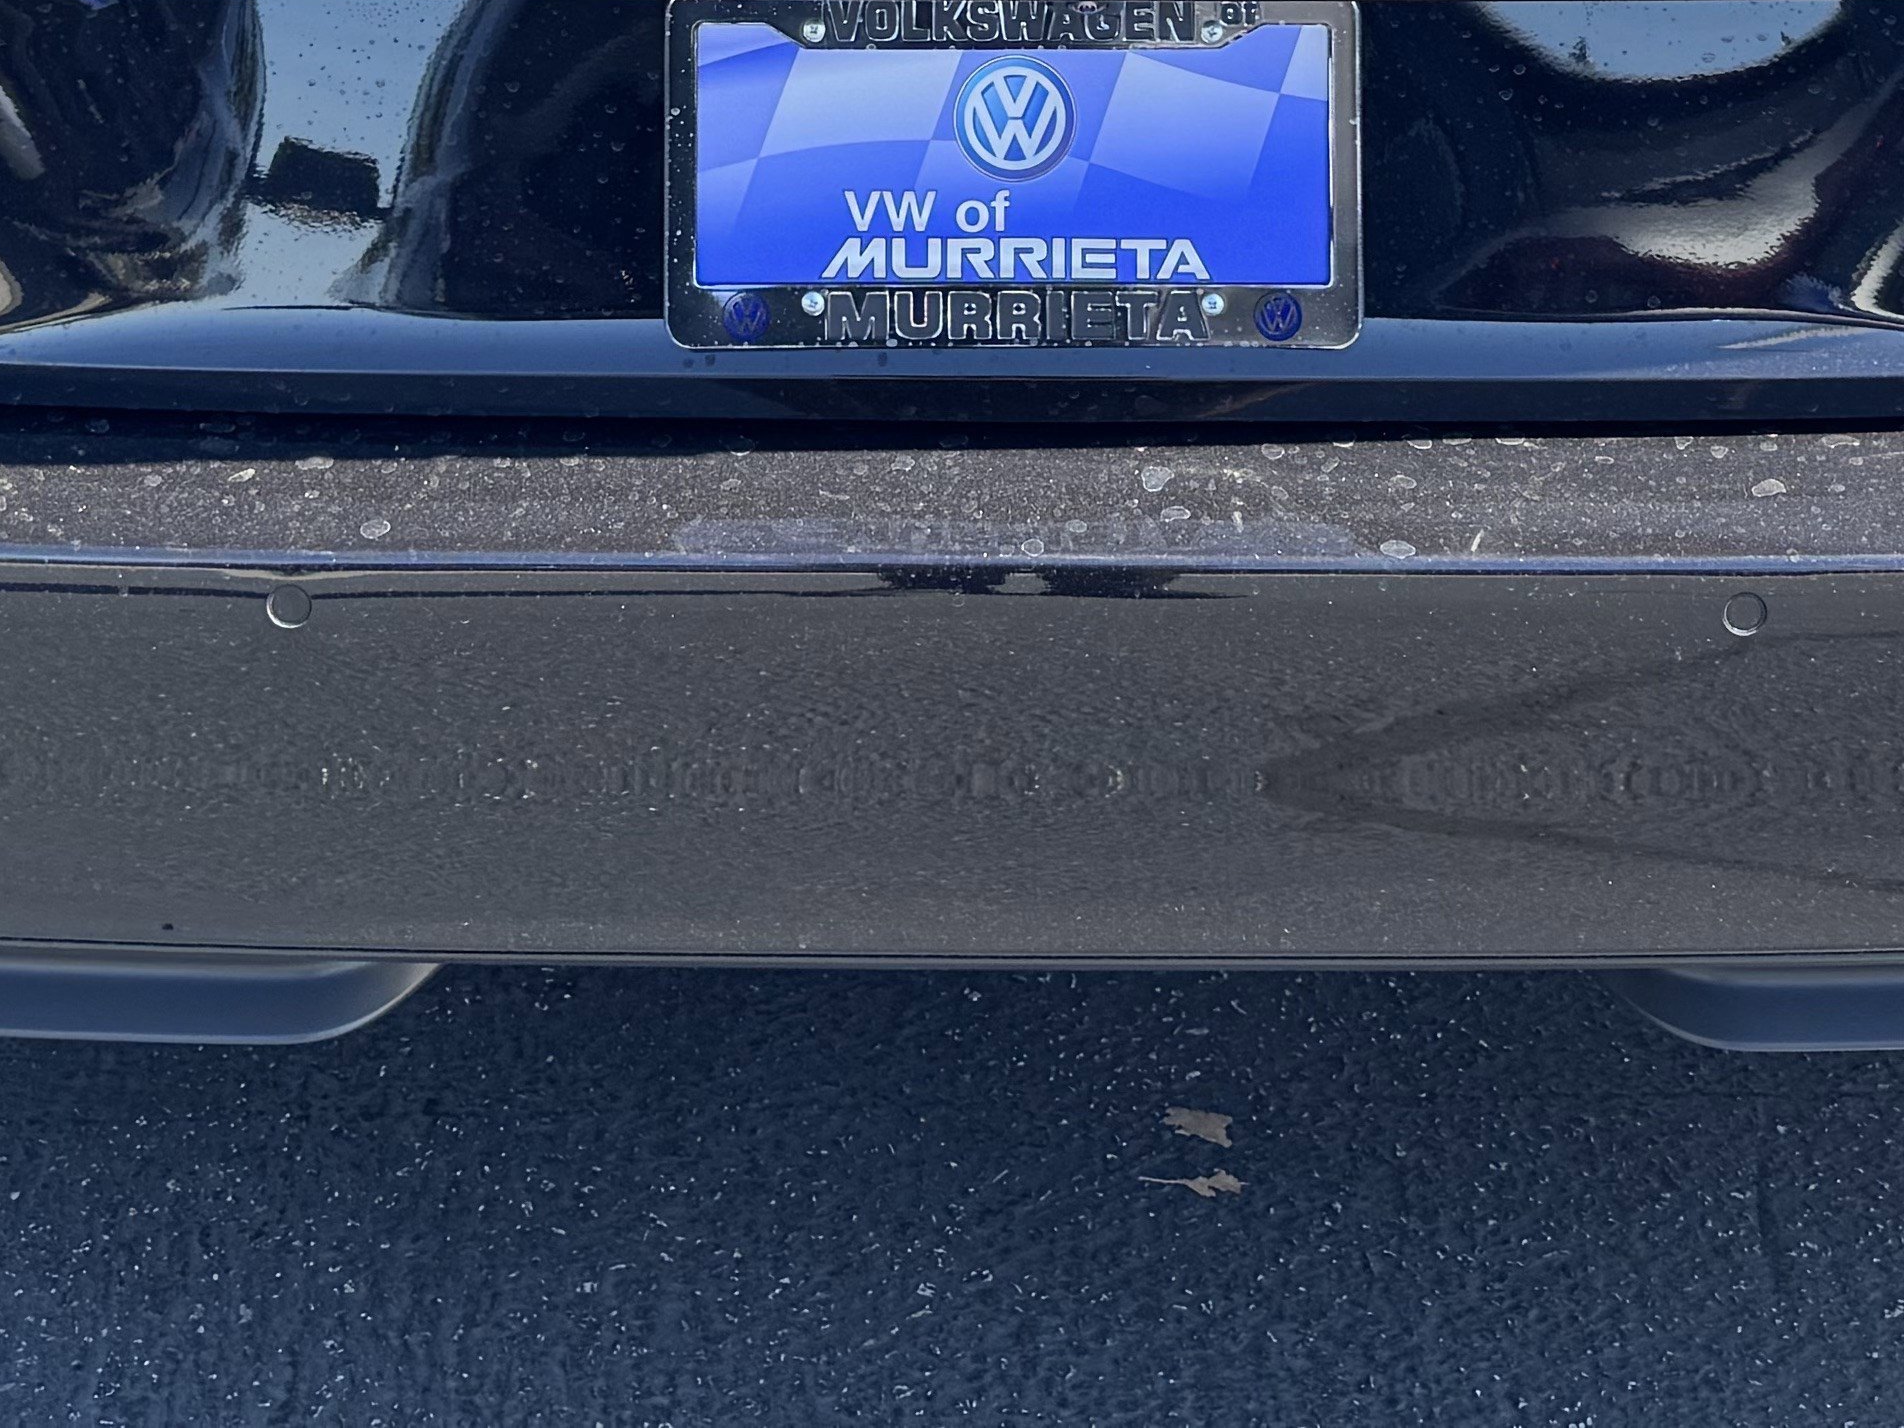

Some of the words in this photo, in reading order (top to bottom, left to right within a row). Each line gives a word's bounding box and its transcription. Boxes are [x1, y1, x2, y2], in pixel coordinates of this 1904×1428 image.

[824, 0, 1195, 42] VOLKSWAGEN
[960, 64, 1070, 172] VW
[842, 191, 937, 232] VW
[955, 190, 1011, 233] of
[821, 238, 1211, 279] MURRIETA
[824, 290, 1210, 341] MURRIETA
